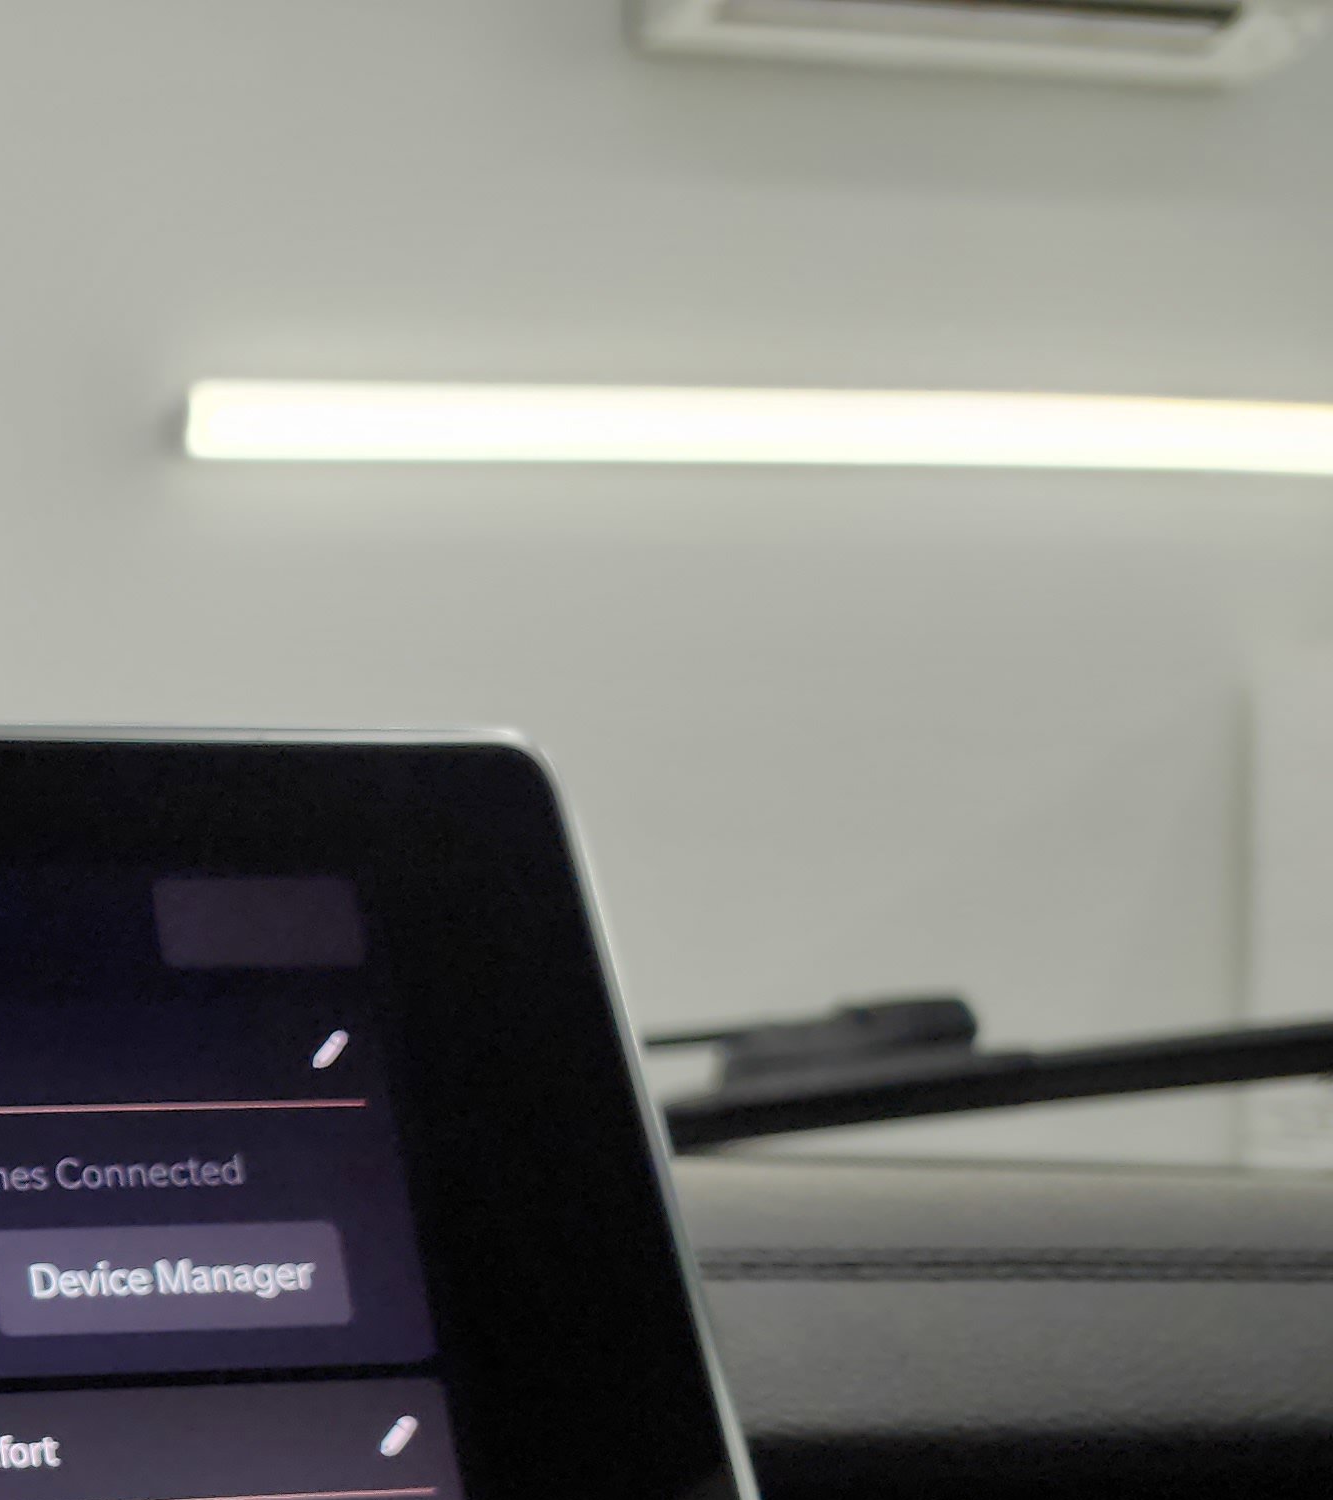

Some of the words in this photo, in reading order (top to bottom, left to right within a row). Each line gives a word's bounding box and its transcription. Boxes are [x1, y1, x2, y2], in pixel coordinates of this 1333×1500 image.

[54, 1153, 244, 1190] Connected
[28, 1259, 155, 1300] Device
[156, 1257, 315, 1299] Manager
